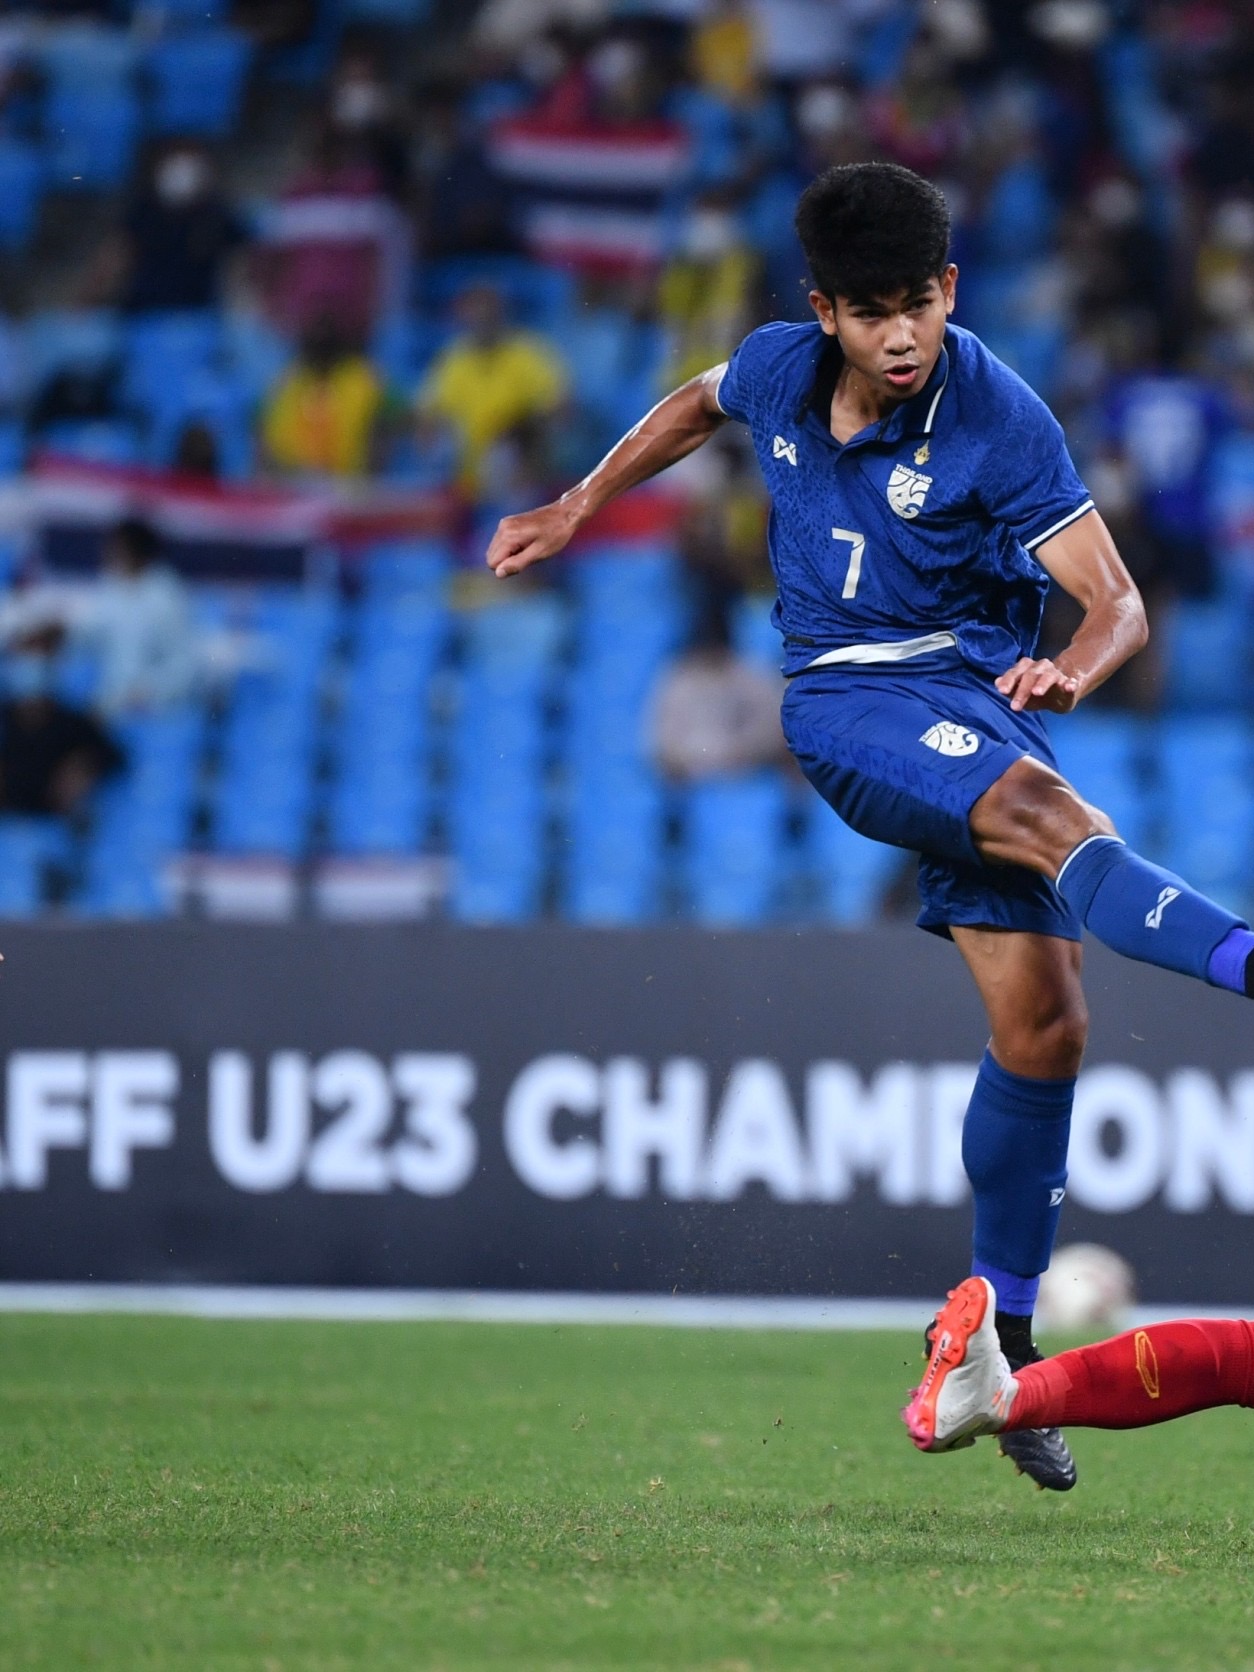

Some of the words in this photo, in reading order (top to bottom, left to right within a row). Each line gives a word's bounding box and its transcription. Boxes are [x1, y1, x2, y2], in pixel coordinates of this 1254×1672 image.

[832, 527, 866, 599] 7
[0, 1049, 180, 1192] FF
[208, 1049, 478, 1197] U23
